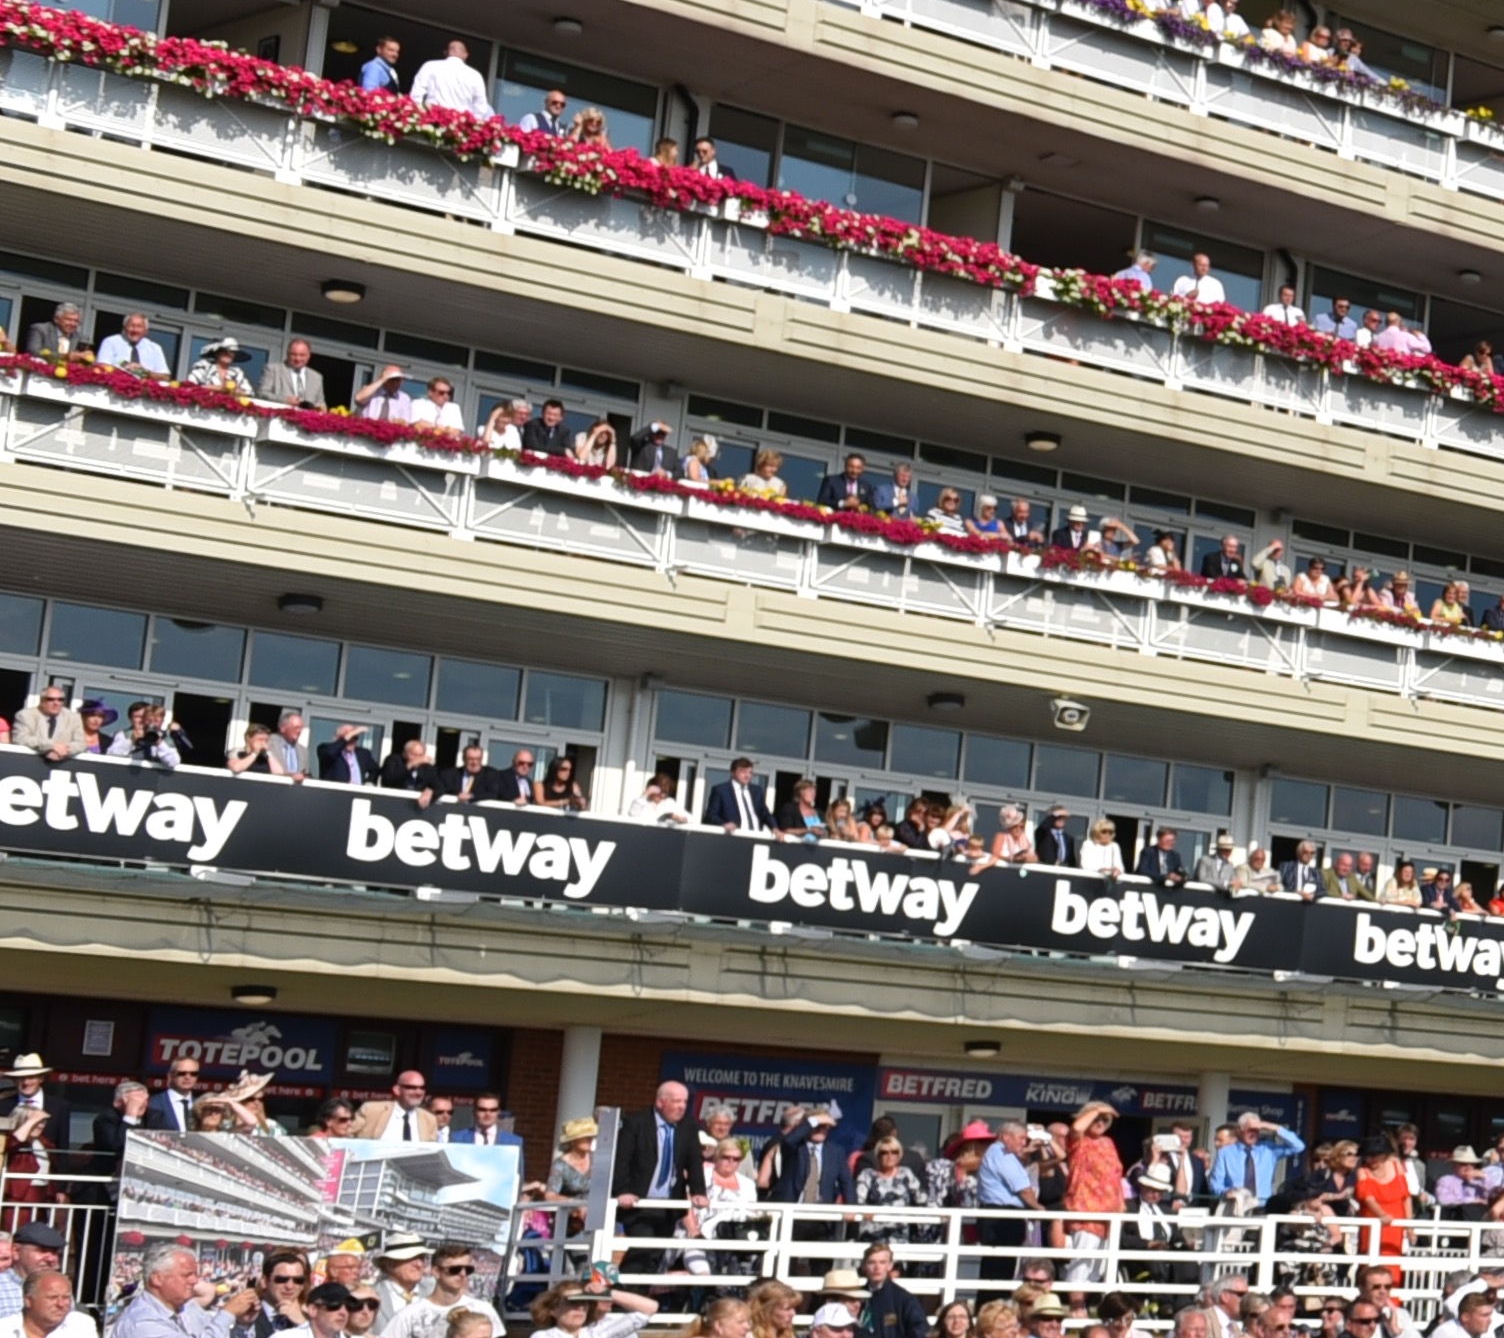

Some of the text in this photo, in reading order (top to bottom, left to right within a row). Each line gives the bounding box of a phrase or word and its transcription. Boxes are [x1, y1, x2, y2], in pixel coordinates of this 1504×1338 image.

[0, 770, 248, 863] etway
[346, 797, 617, 899] betway
[748, 844, 980, 937] betway
[1051, 879, 1255, 963] betway
[159, 1037, 324, 1072] TOTEPOOL
[684, 1066, 855, 1093] WELCOME TO THE KNAVESMIRE
[886, 1073, 993, 1099] BETFRED
[1143, 1092, 1198, 1111] BETFR
